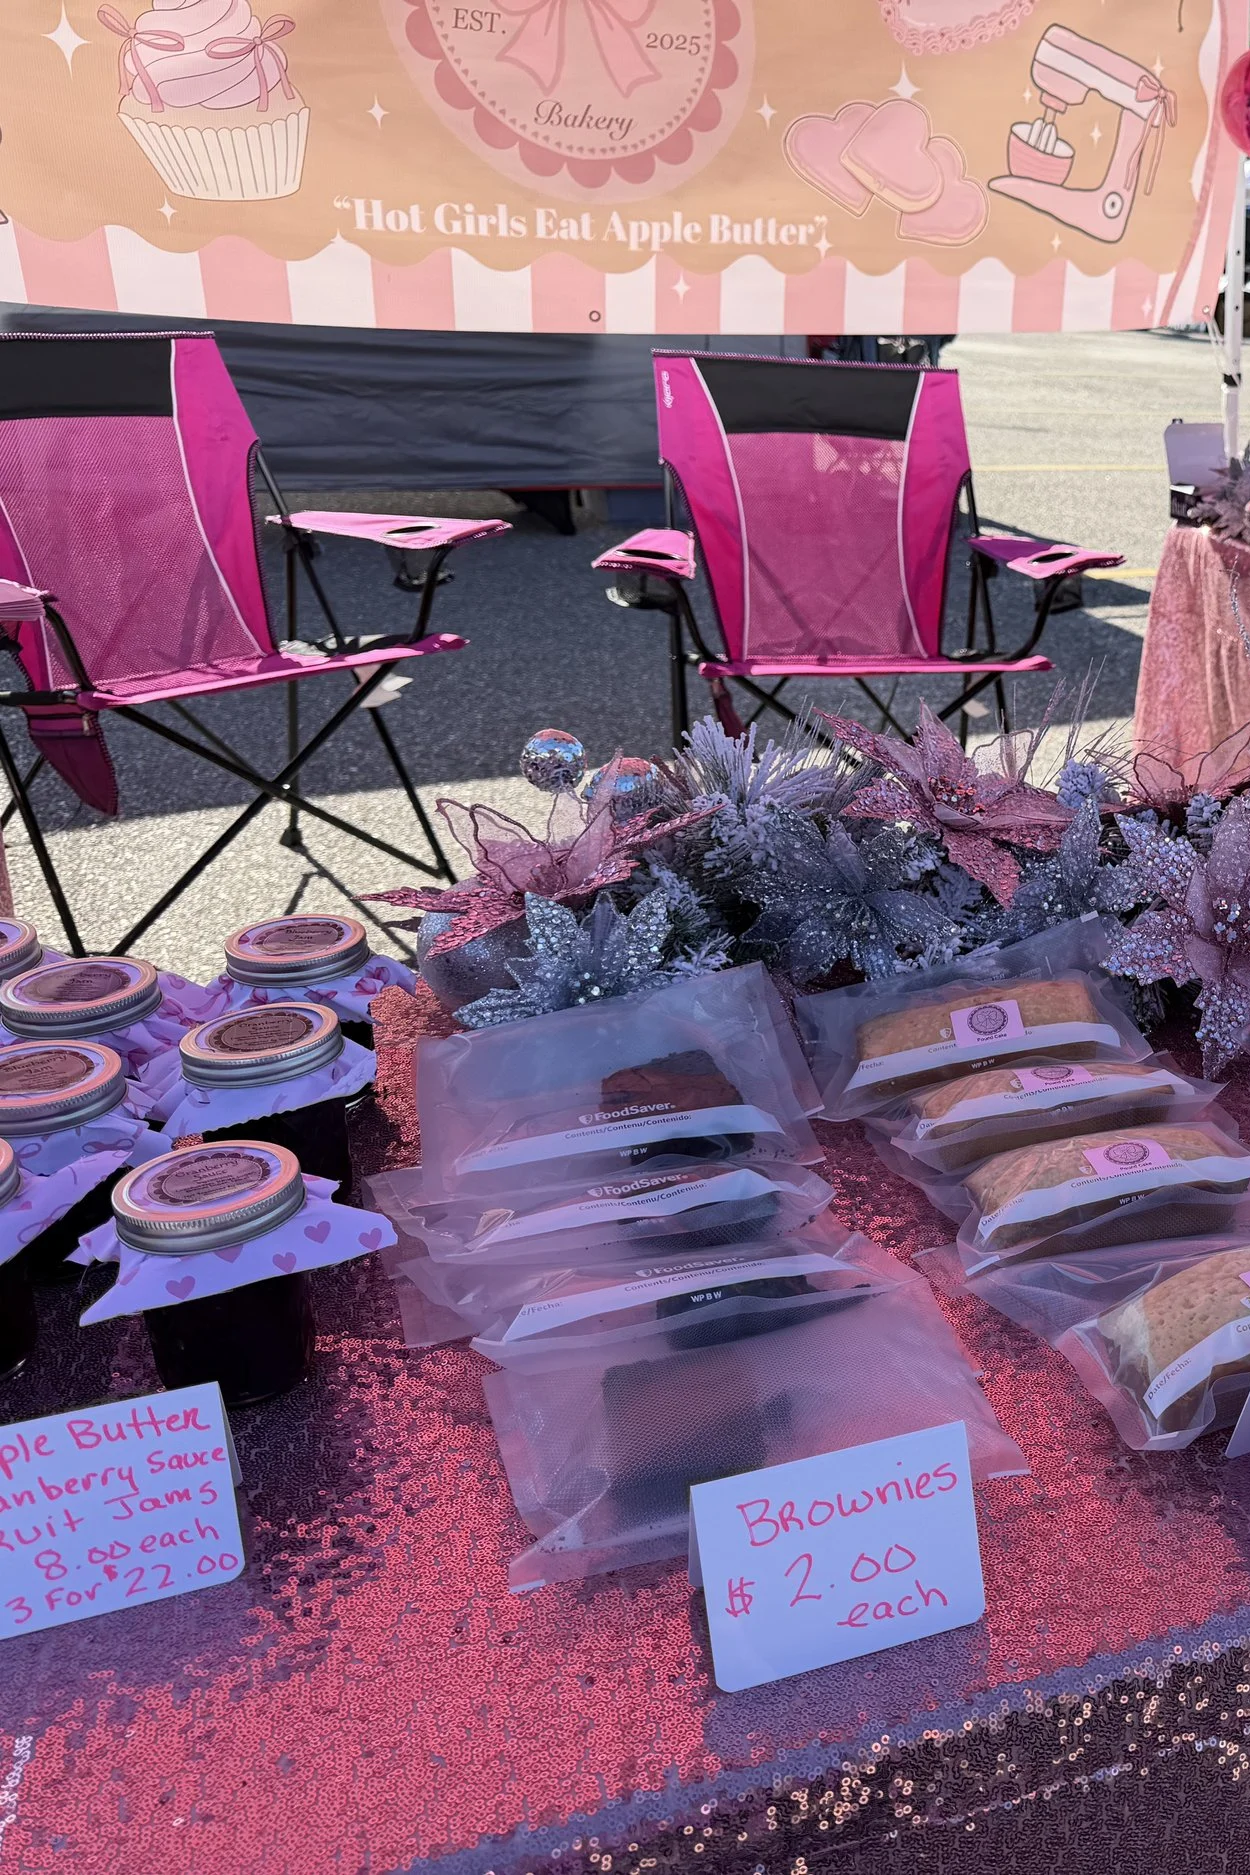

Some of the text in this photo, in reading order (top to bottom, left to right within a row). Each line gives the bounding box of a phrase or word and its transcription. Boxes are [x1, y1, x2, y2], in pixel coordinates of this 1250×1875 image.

[453, 8, 508, 35] EST.
[645, 31, 703, 56] 2025
[534, 100, 636, 141] Bakery
[433, 203, 527, 238] Girls
[536, 208, 596, 242] Eat
[603, 212, 702, 251] Apple
[175, 1159, 239, 1178] Cranberry
[147, 1447, 226, 1474] Sauce
[138, 1517, 220, 1553] each
[5, 1596, 33, 1625] 3
[836, 1579, 948, 1629] each
